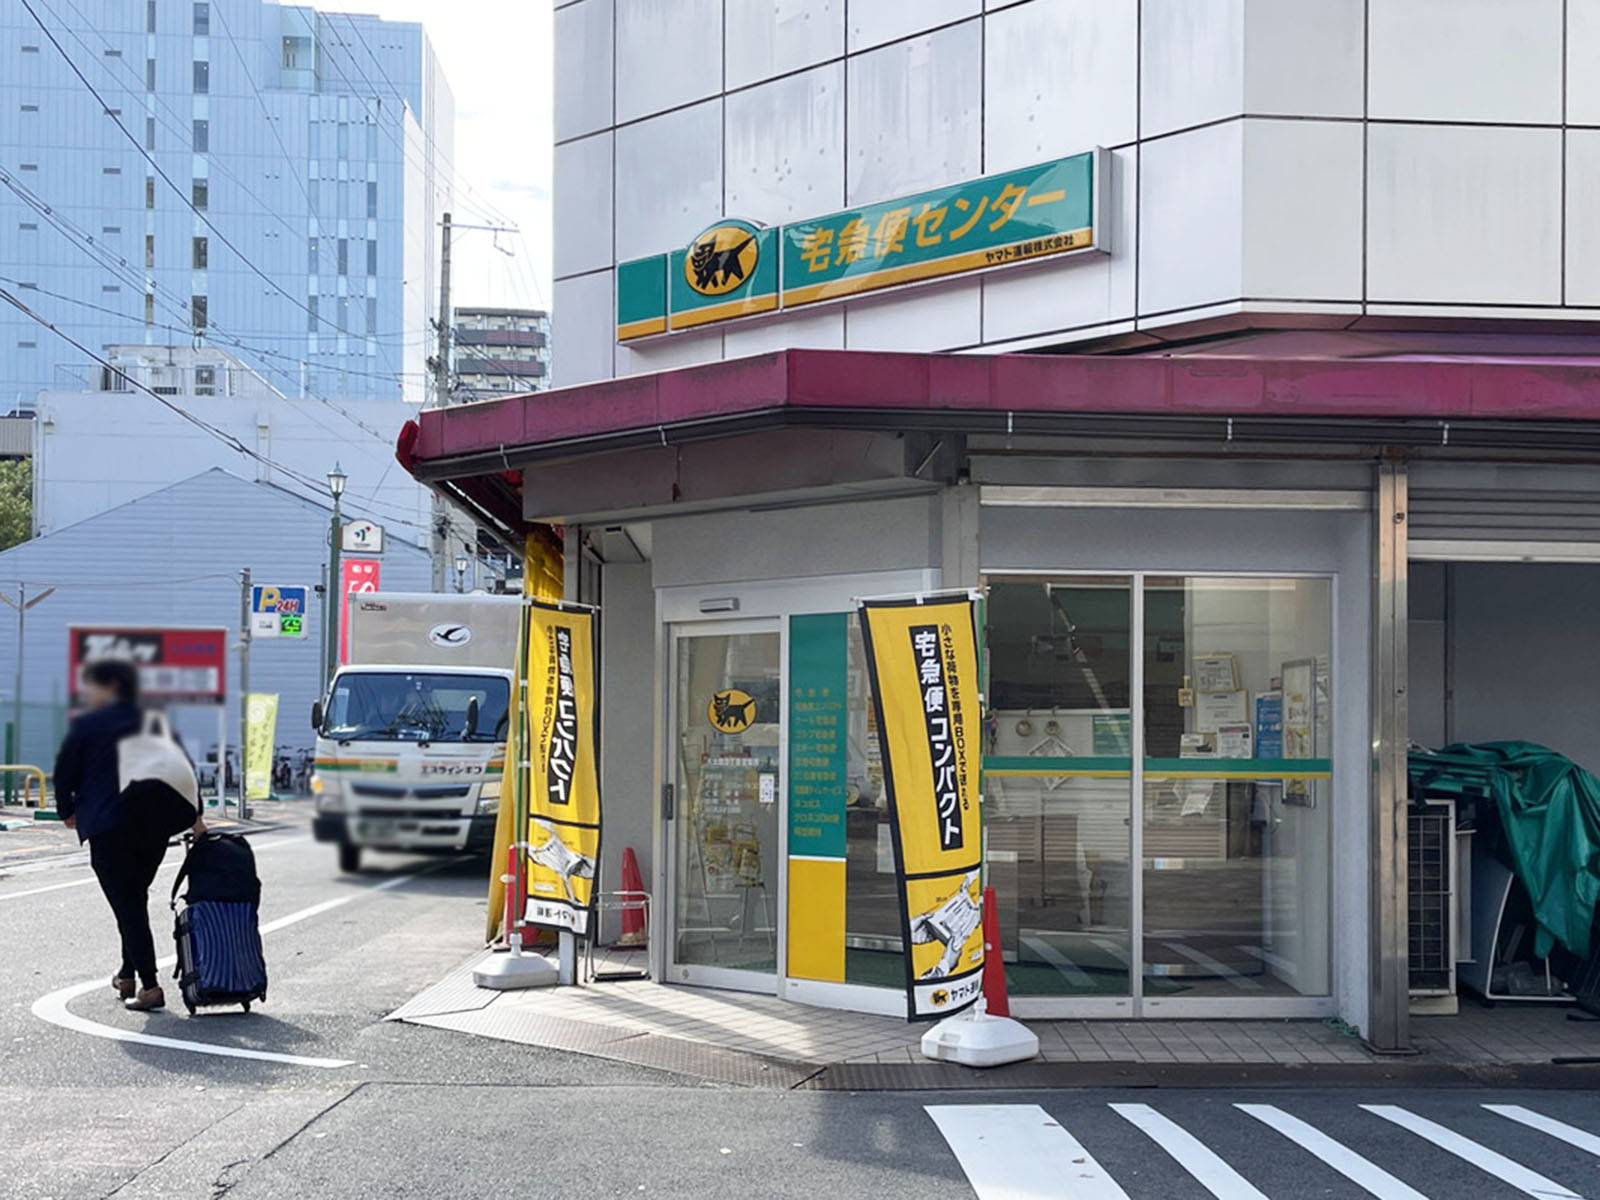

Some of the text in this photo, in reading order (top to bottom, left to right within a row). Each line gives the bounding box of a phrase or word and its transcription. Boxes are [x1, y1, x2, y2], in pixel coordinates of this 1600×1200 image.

[801, 183, 1067, 273] 宅急便センター
[985, 234, 1074, 262] ヤマト運輸株式会社
[258, 587, 281, 612] P
[914, 630, 960, 846] 宅急便コンパクト
